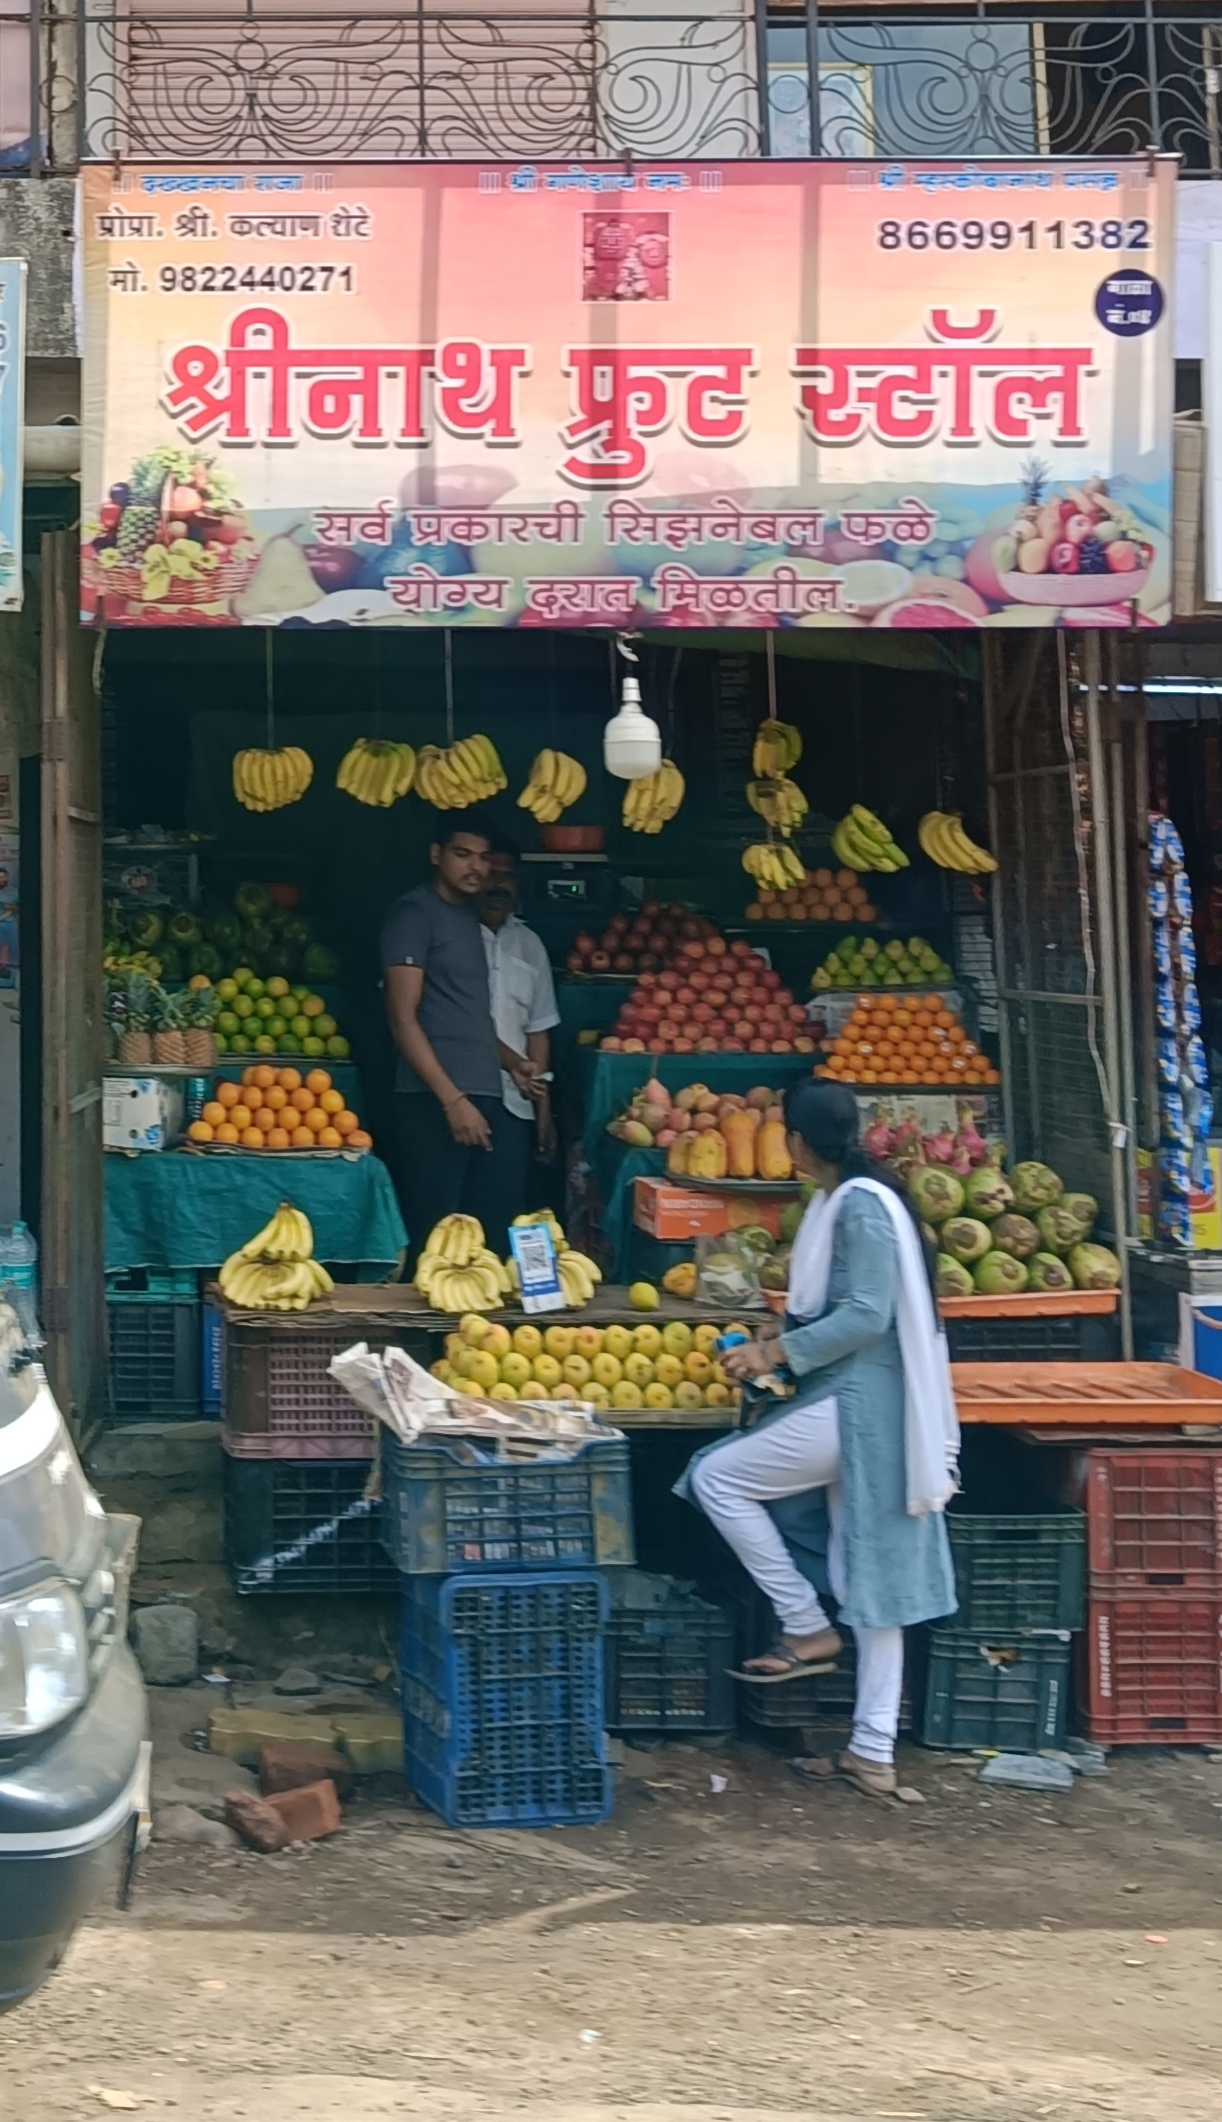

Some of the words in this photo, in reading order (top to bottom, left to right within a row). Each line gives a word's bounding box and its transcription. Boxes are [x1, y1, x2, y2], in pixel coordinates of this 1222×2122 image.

[95, 206, 165, 238] प्रोप्रा.
[174, 206, 218, 238] श्री.
[228, 214, 322, 238] कल्याण
[878, 220, 1151, 250] 8669911382
[109, 262, 148, 293] मो.
[159, 265, 354, 293] 9822440271
[164, 306, 527, 440] श्रीनाथ
[795, 308, 1094, 439] स्टॉल
[312, 501, 395, 543] सर्व
[409, 501, 585, 543] प्रकारची
[603, 500, 825, 548] सिझनेबल
[840, 500, 937, 543] फळे
[387, 565, 510, 609] योग्य
[526, 578, 637, 616] दरात
